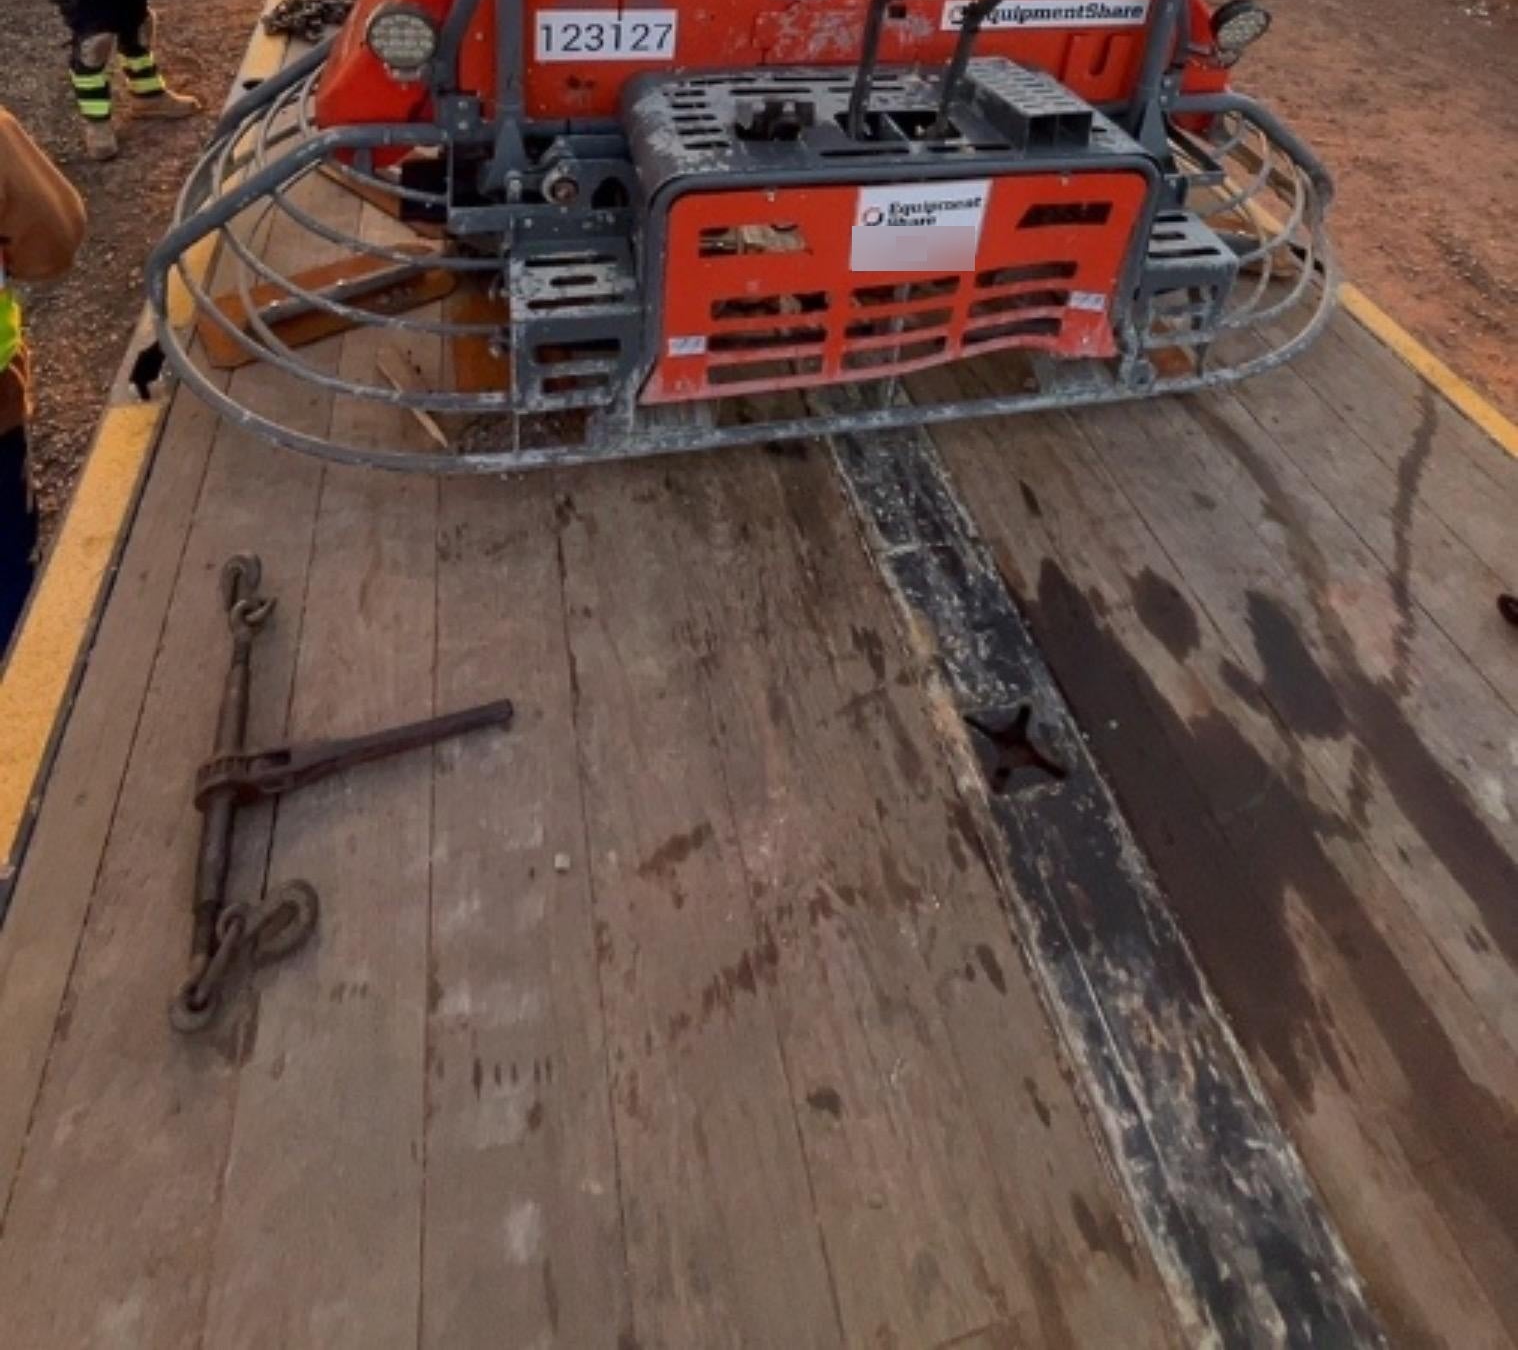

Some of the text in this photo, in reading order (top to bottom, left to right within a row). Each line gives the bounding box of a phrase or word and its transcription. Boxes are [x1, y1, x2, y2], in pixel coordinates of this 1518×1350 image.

[984, 3, 1144, 25] quipmentShare
[541, 23, 673, 51] 123127
[889, 196, 982, 217] Equipment
